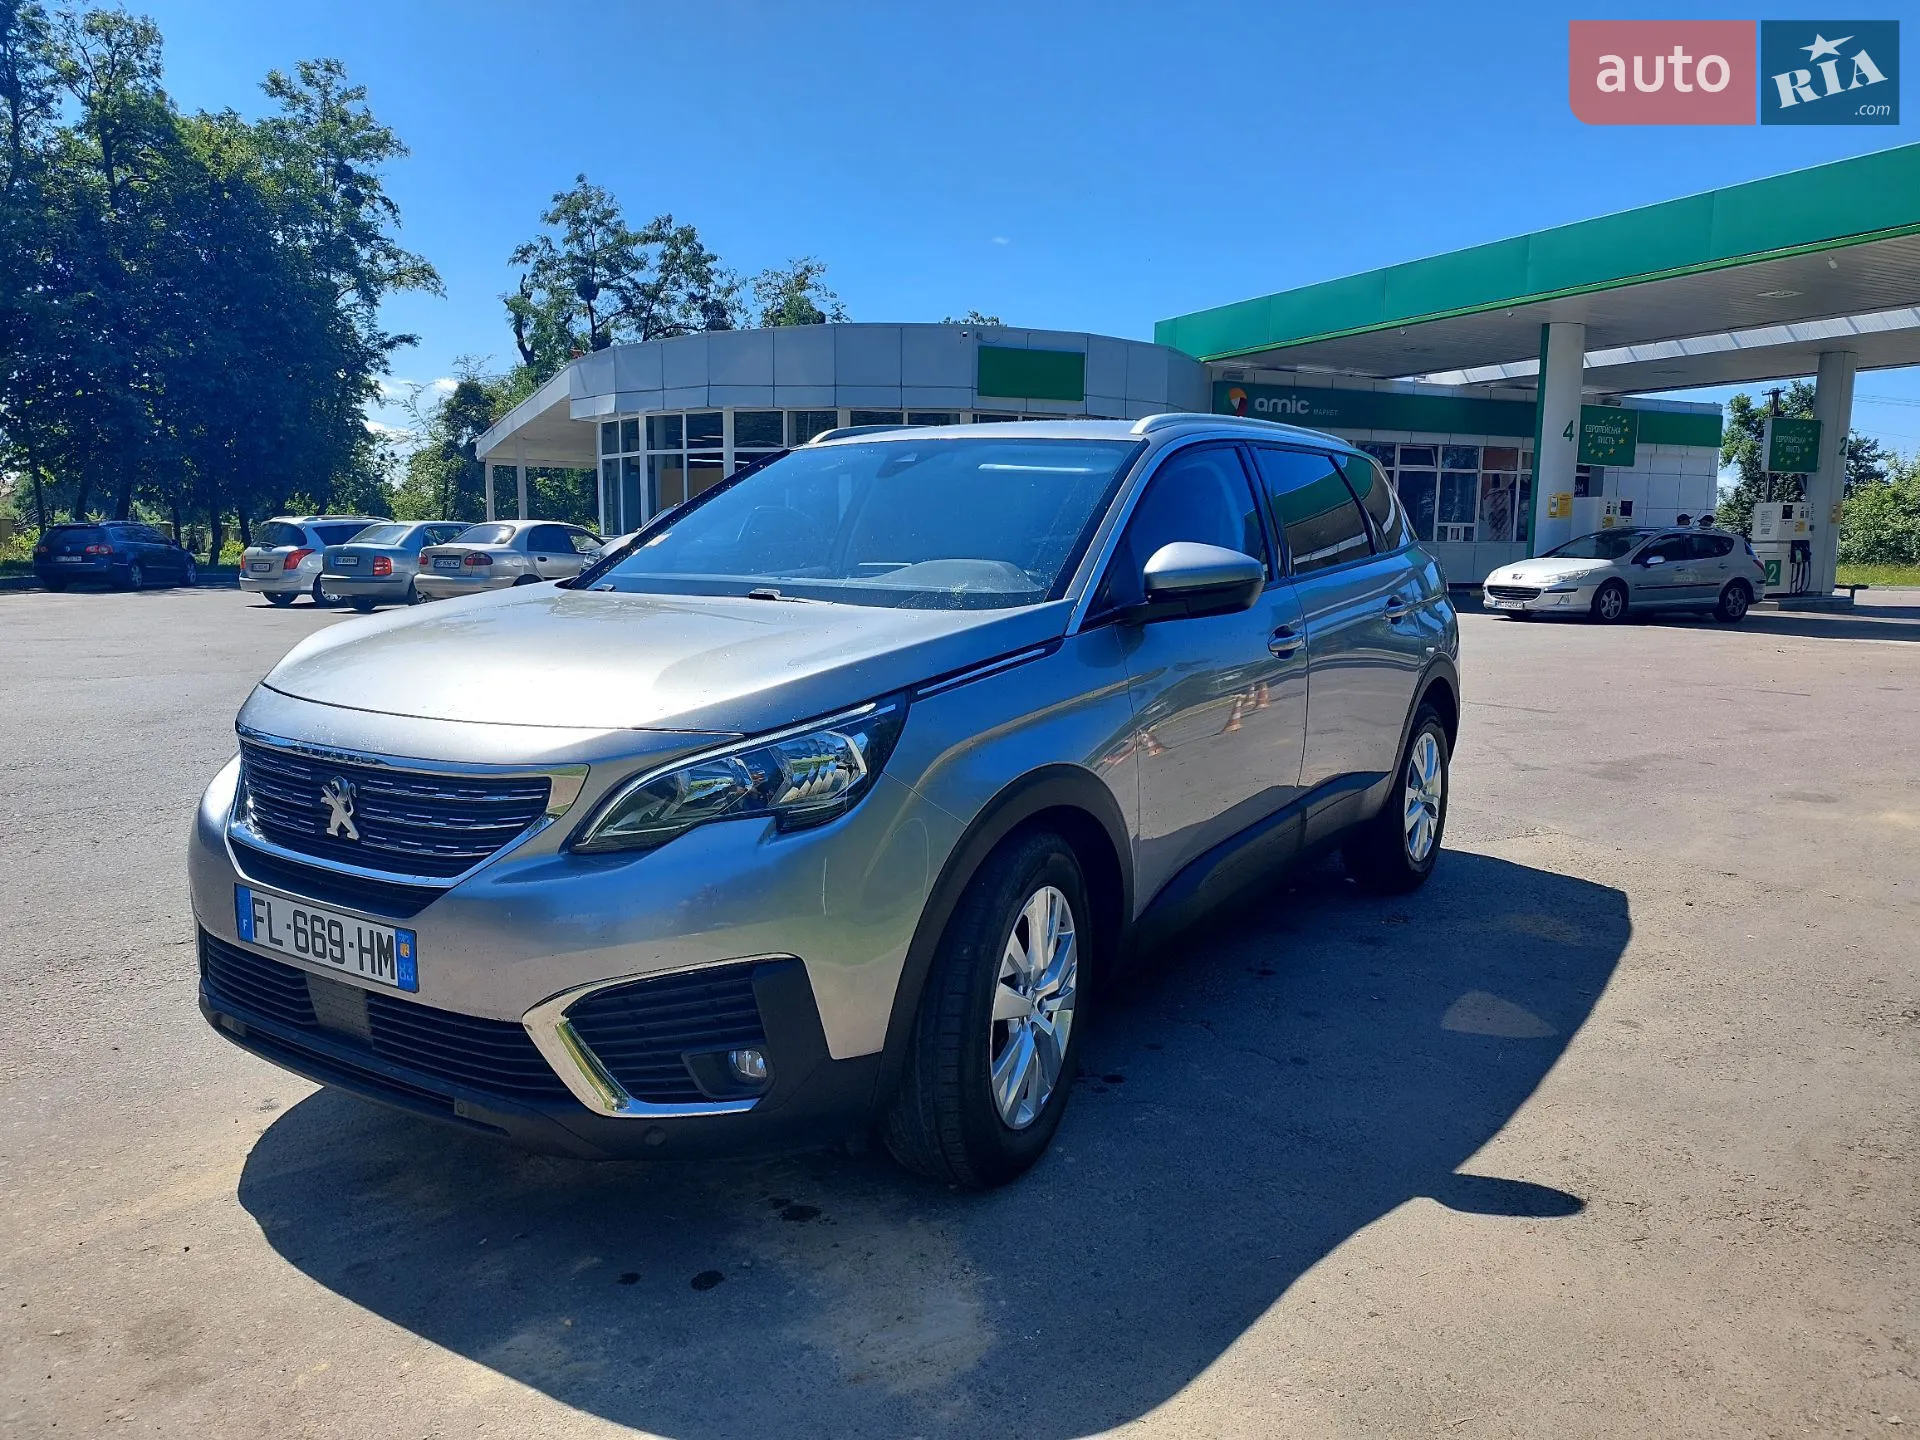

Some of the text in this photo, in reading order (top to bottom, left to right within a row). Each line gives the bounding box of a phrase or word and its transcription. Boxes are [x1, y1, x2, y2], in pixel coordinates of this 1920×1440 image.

[1254, 395, 1310, 414] amic
[1563, 420, 1574, 442] 4
[1838, 437, 1848, 456] 2
[1768, 563, 1777, 583] 2
[252, 897, 396, 980] FL-669-HM
